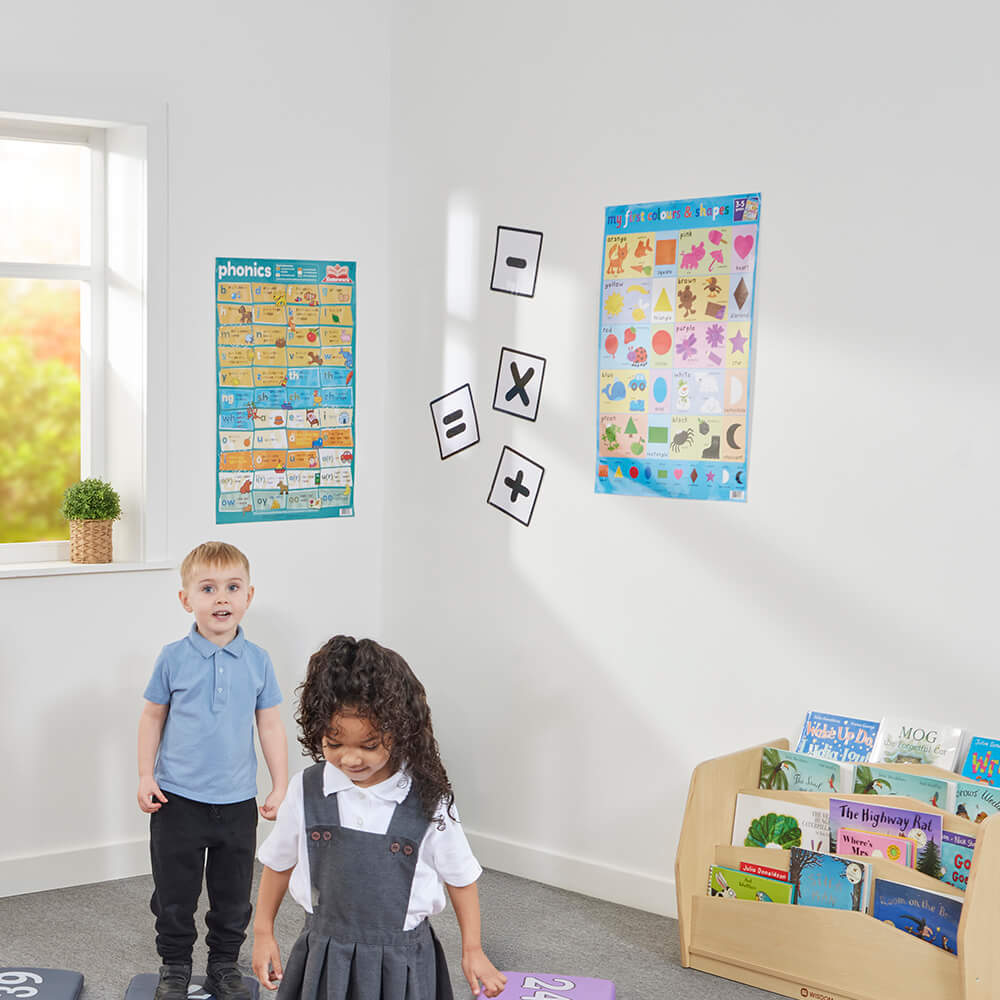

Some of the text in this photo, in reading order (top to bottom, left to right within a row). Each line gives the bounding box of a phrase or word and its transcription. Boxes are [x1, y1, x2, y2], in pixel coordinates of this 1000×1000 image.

[607, 215, 622, 229] my
[695, 203, 730, 221] shapes
[218, 260, 272, 280] phonics
[838, 726, 855, 745] Up
[899, 726, 937, 743] MOG
[840, 805, 933, 832] The Highway Rat
[843, 834, 873, 848] Where's
